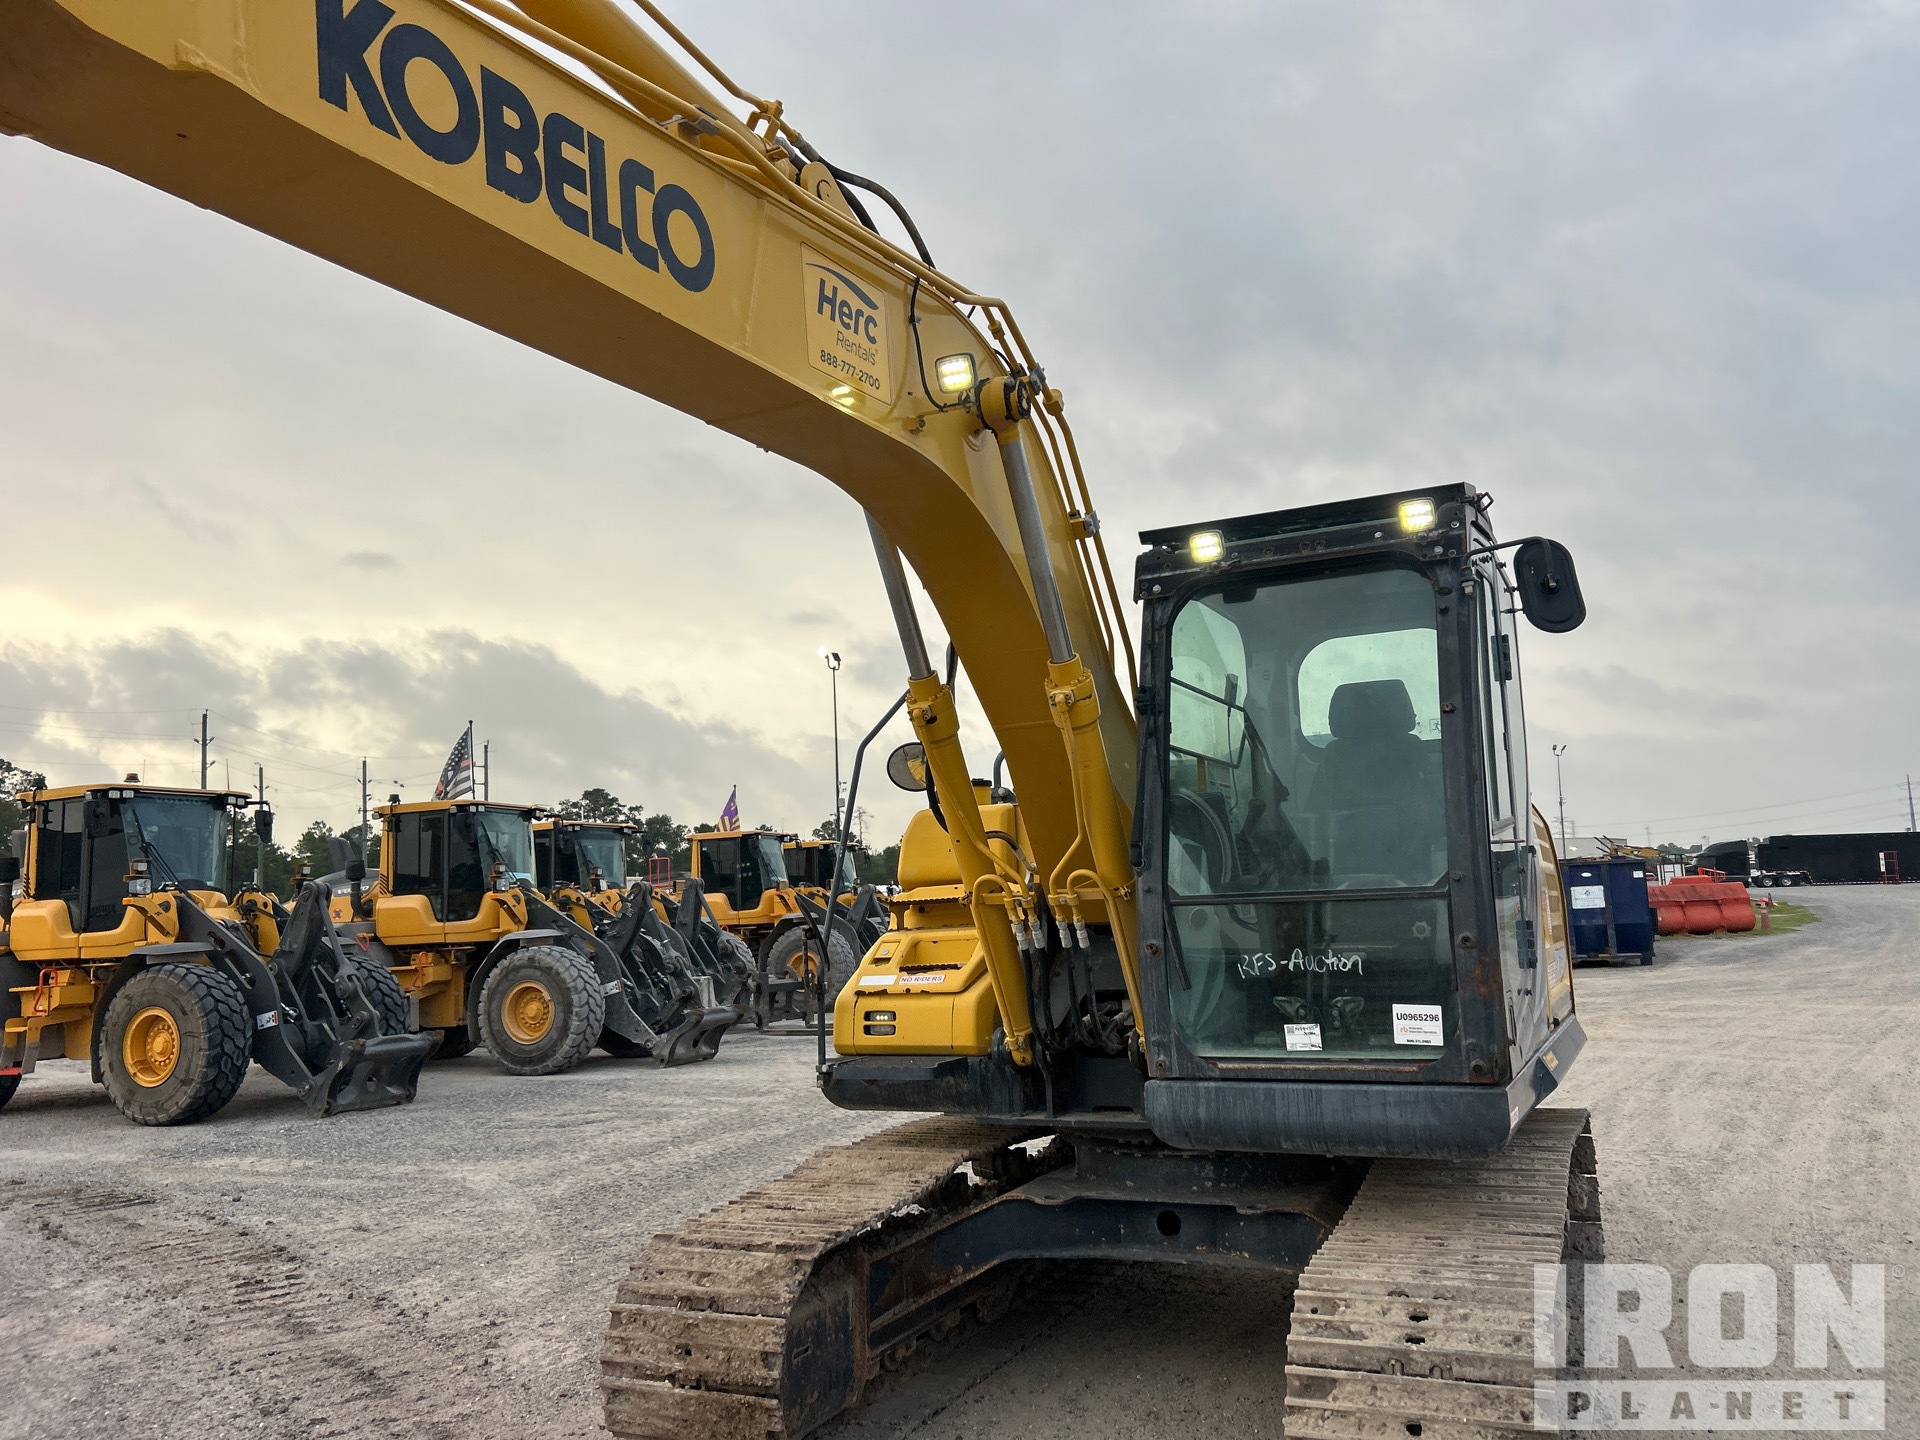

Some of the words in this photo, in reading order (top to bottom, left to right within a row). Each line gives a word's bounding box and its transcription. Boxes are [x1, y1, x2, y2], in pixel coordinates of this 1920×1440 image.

[316, 0, 716, 293] KOBELCO
[817, 277, 878, 345] Herc
[836, 330, 876, 366] Rentals
[820, 349, 881, 391] 888-777-2700
[337, 885, 370, 894] VOO
[1396, 1012, 1440, 1022] U0965296
